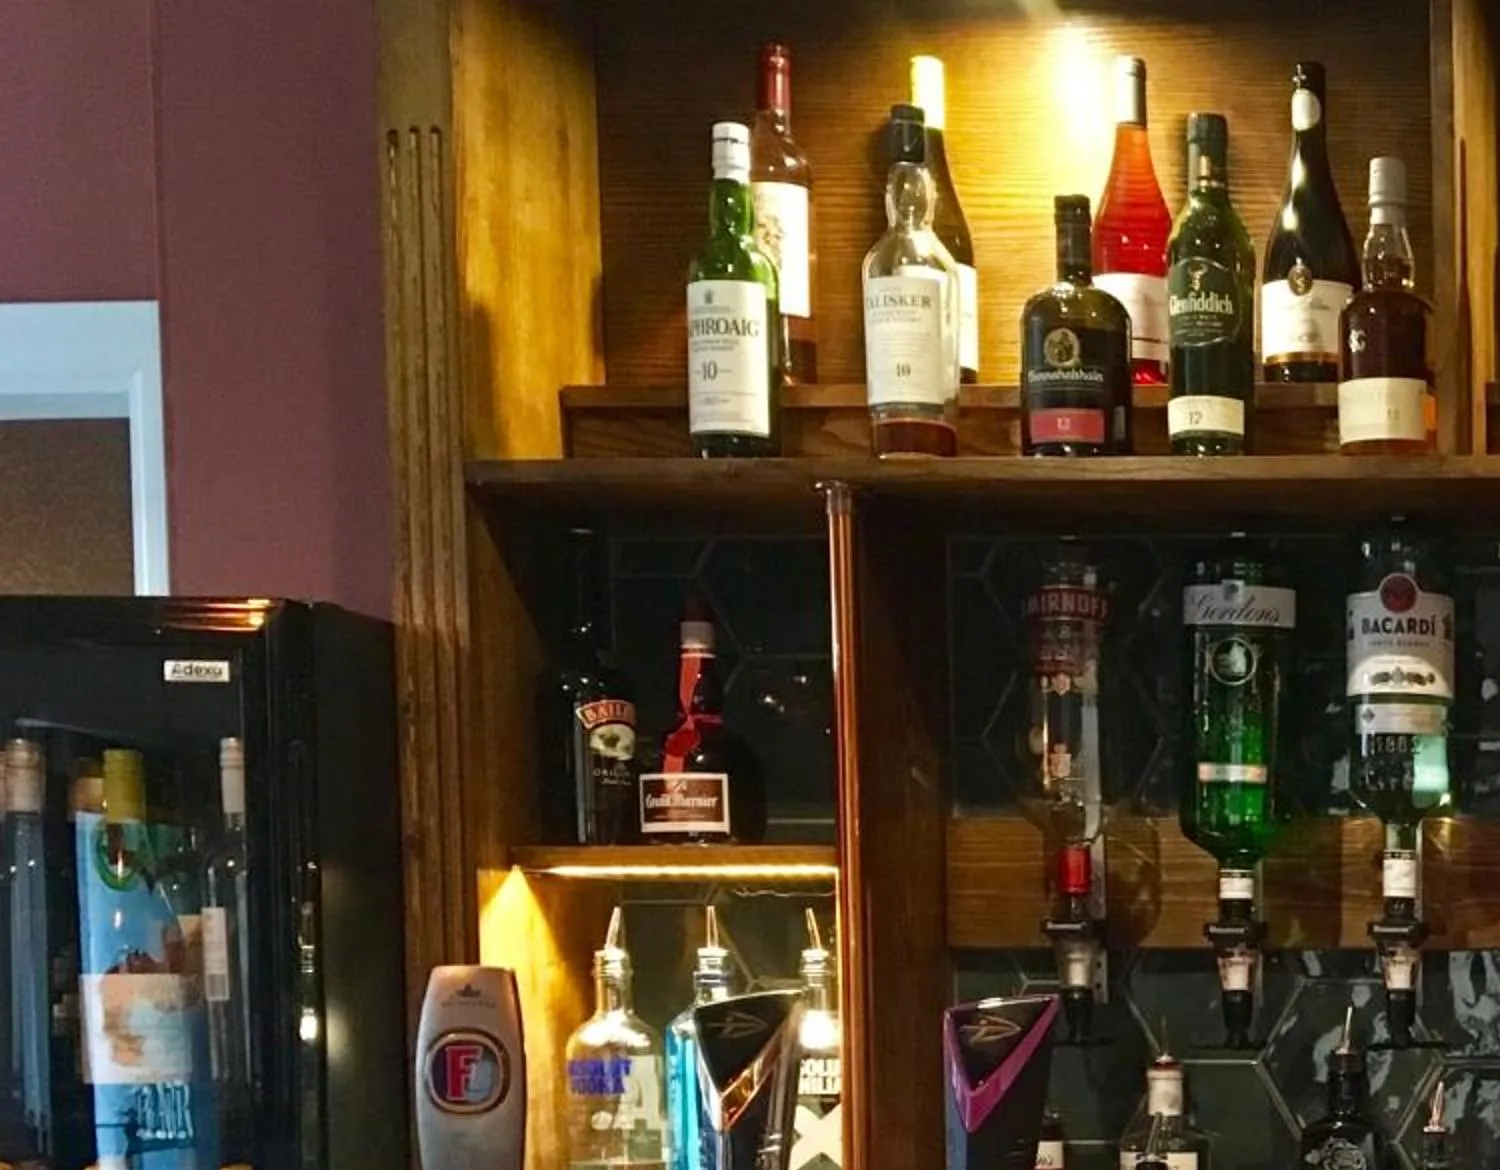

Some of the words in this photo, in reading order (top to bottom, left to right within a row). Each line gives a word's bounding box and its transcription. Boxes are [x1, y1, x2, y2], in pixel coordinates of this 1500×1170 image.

[867, 294, 932, 308] ALISKER
[701, 360, 719, 381] 10
[584, 703, 628, 722] BAIL
